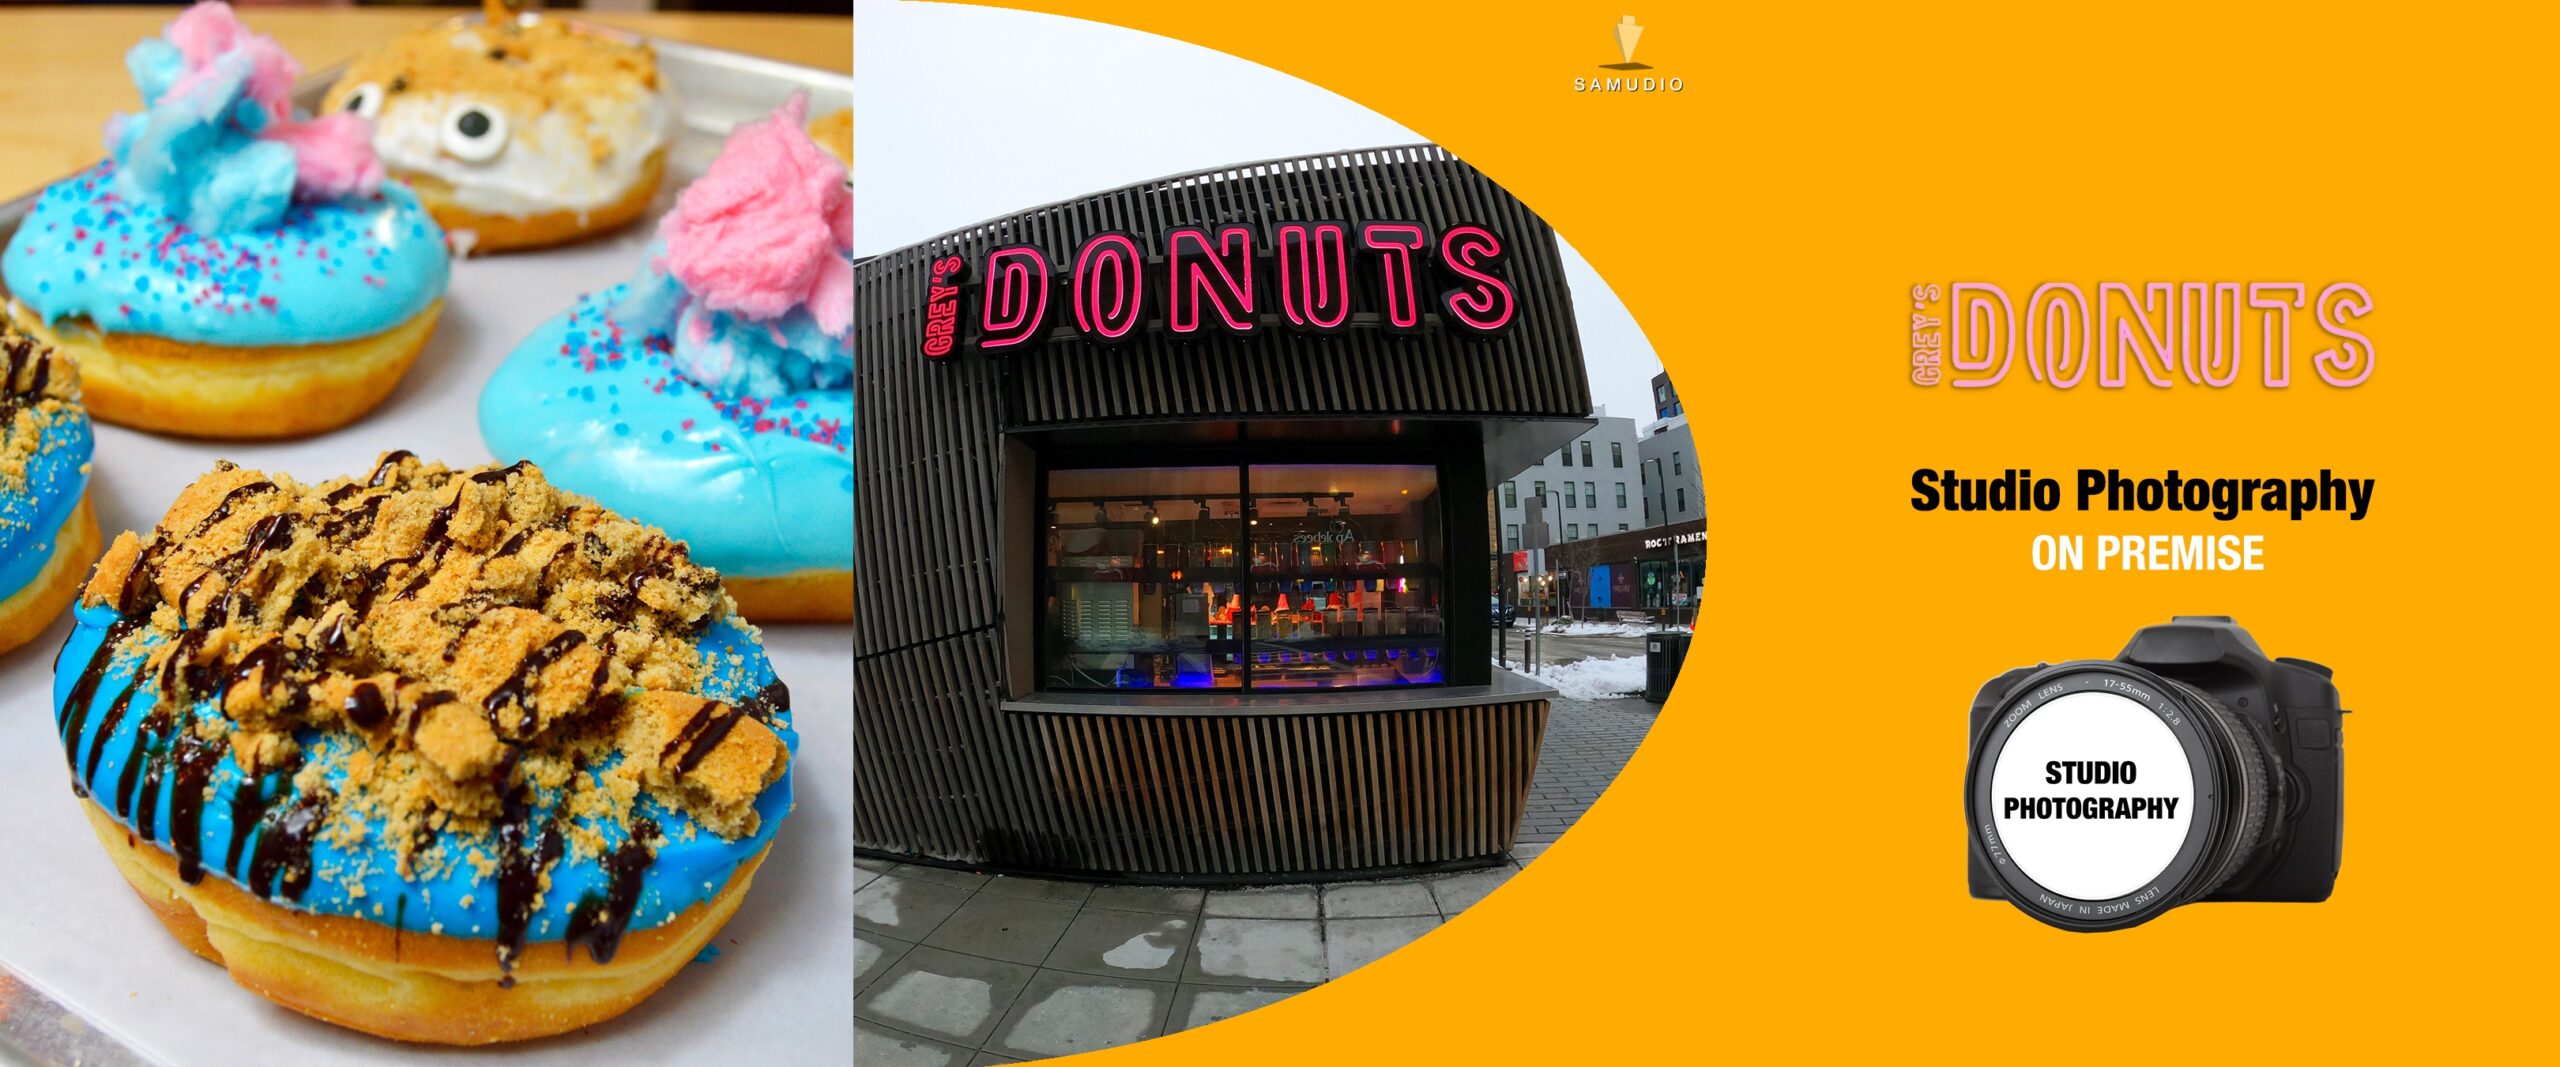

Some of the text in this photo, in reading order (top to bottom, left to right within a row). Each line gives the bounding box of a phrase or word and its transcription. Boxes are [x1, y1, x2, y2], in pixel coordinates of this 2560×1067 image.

[922, 223, 1515, 357] GREY'S DONUTS
[2003, 699, 2033, 728] ZOOM
[2037, 682, 2064, 701] LENS
[2103, 678, 2151, 701] 17-55mm
[2157, 702, 2181, 727] 1:2.8
[2039, 886, 2160, 915] LENS MADE IN JAPAN
